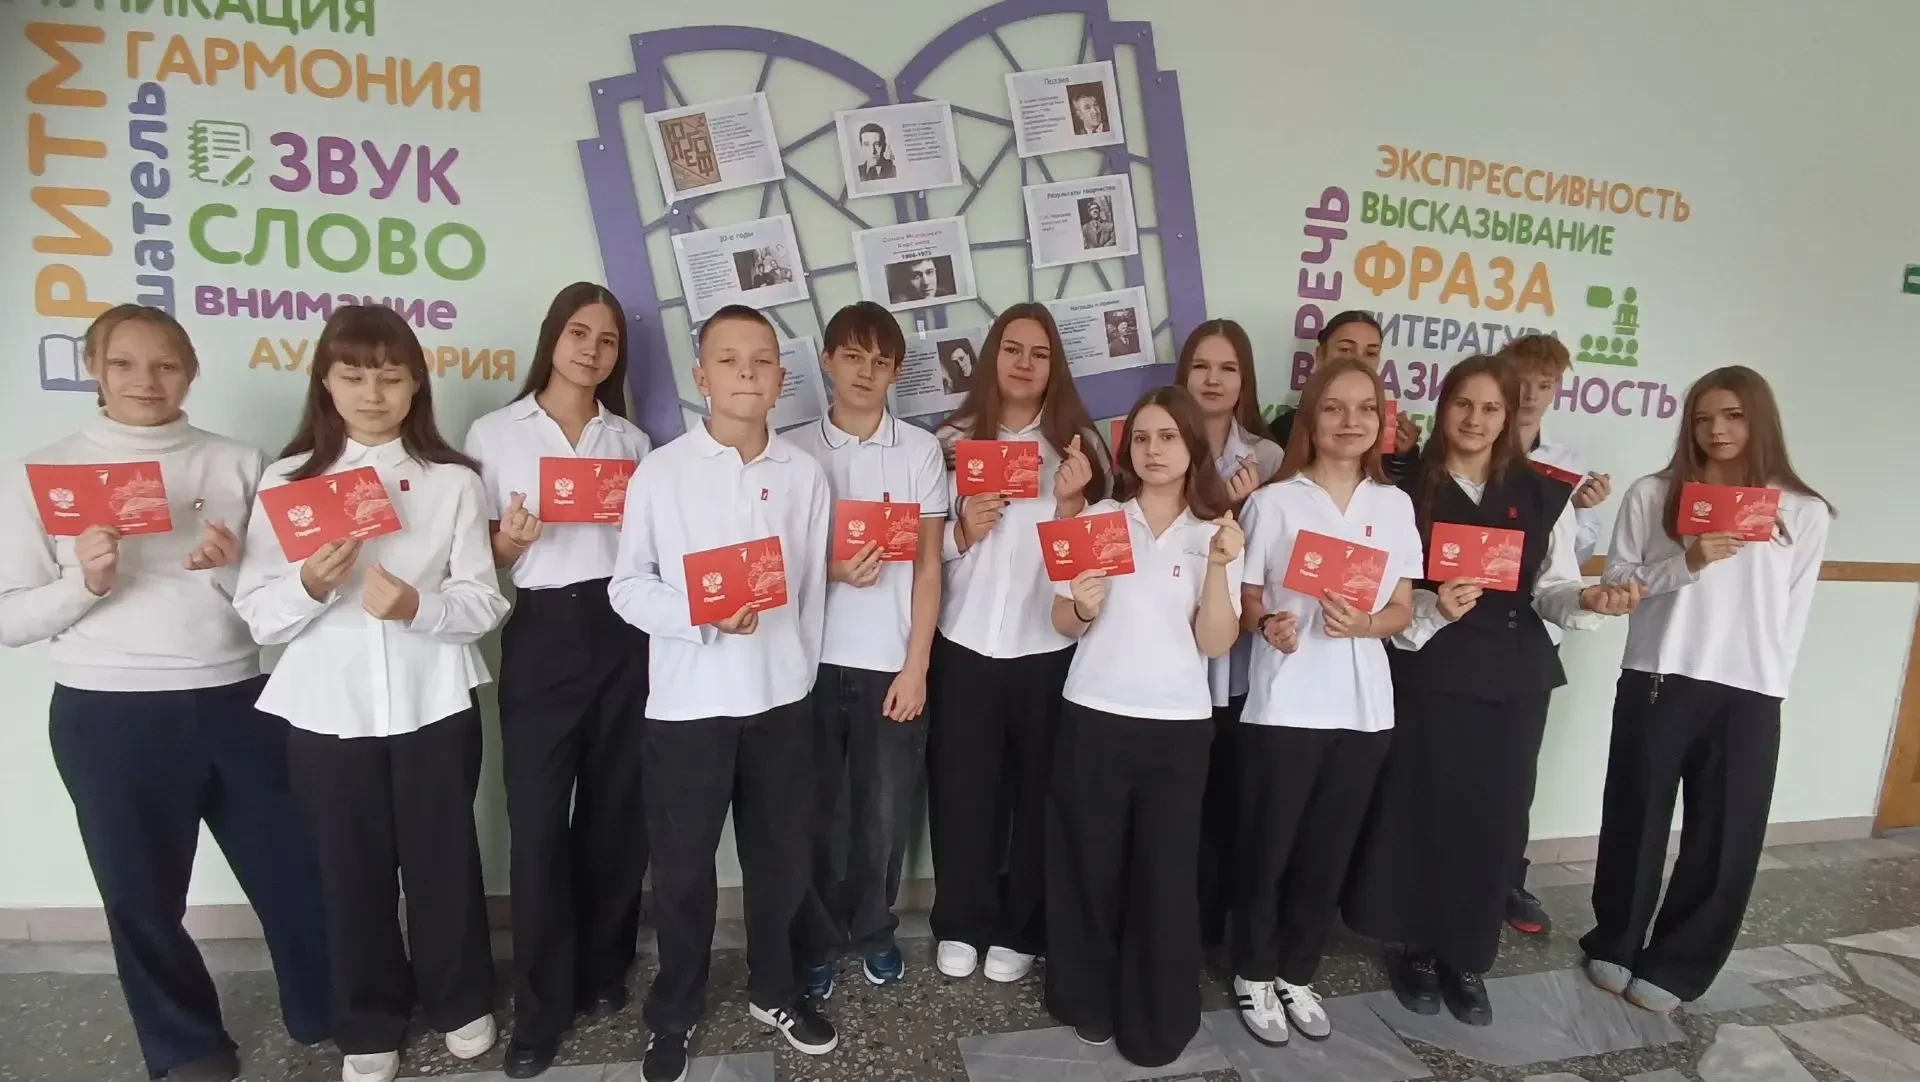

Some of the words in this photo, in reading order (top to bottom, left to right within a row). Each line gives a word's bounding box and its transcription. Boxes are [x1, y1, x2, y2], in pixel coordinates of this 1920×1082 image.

[124, 30, 482, 112] ГАРМОНИЯ
[24, 21, 113, 320] РИТМ
[269, 131, 461, 205] ЗВУК
[1375, 144, 1691, 223] ЭКСПРЕССИВНОСТЬ
[188, 202, 487, 281] СЛОВО
[1359, 190, 1616, 256] ВЫСКАЗЫВАНИЕ
[1294, 185, 1351, 341] РЕЧЬ
[1353, 240, 1556, 317] ФРАЗА
[194, 285, 458, 330] внимие
[1362, 311, 1560, 355] ИТЕРАТУ
[248, 336, 517, 382] АУРИЯ
[1290, 351, 1678, 420] ВАЗИНОСТЬ
